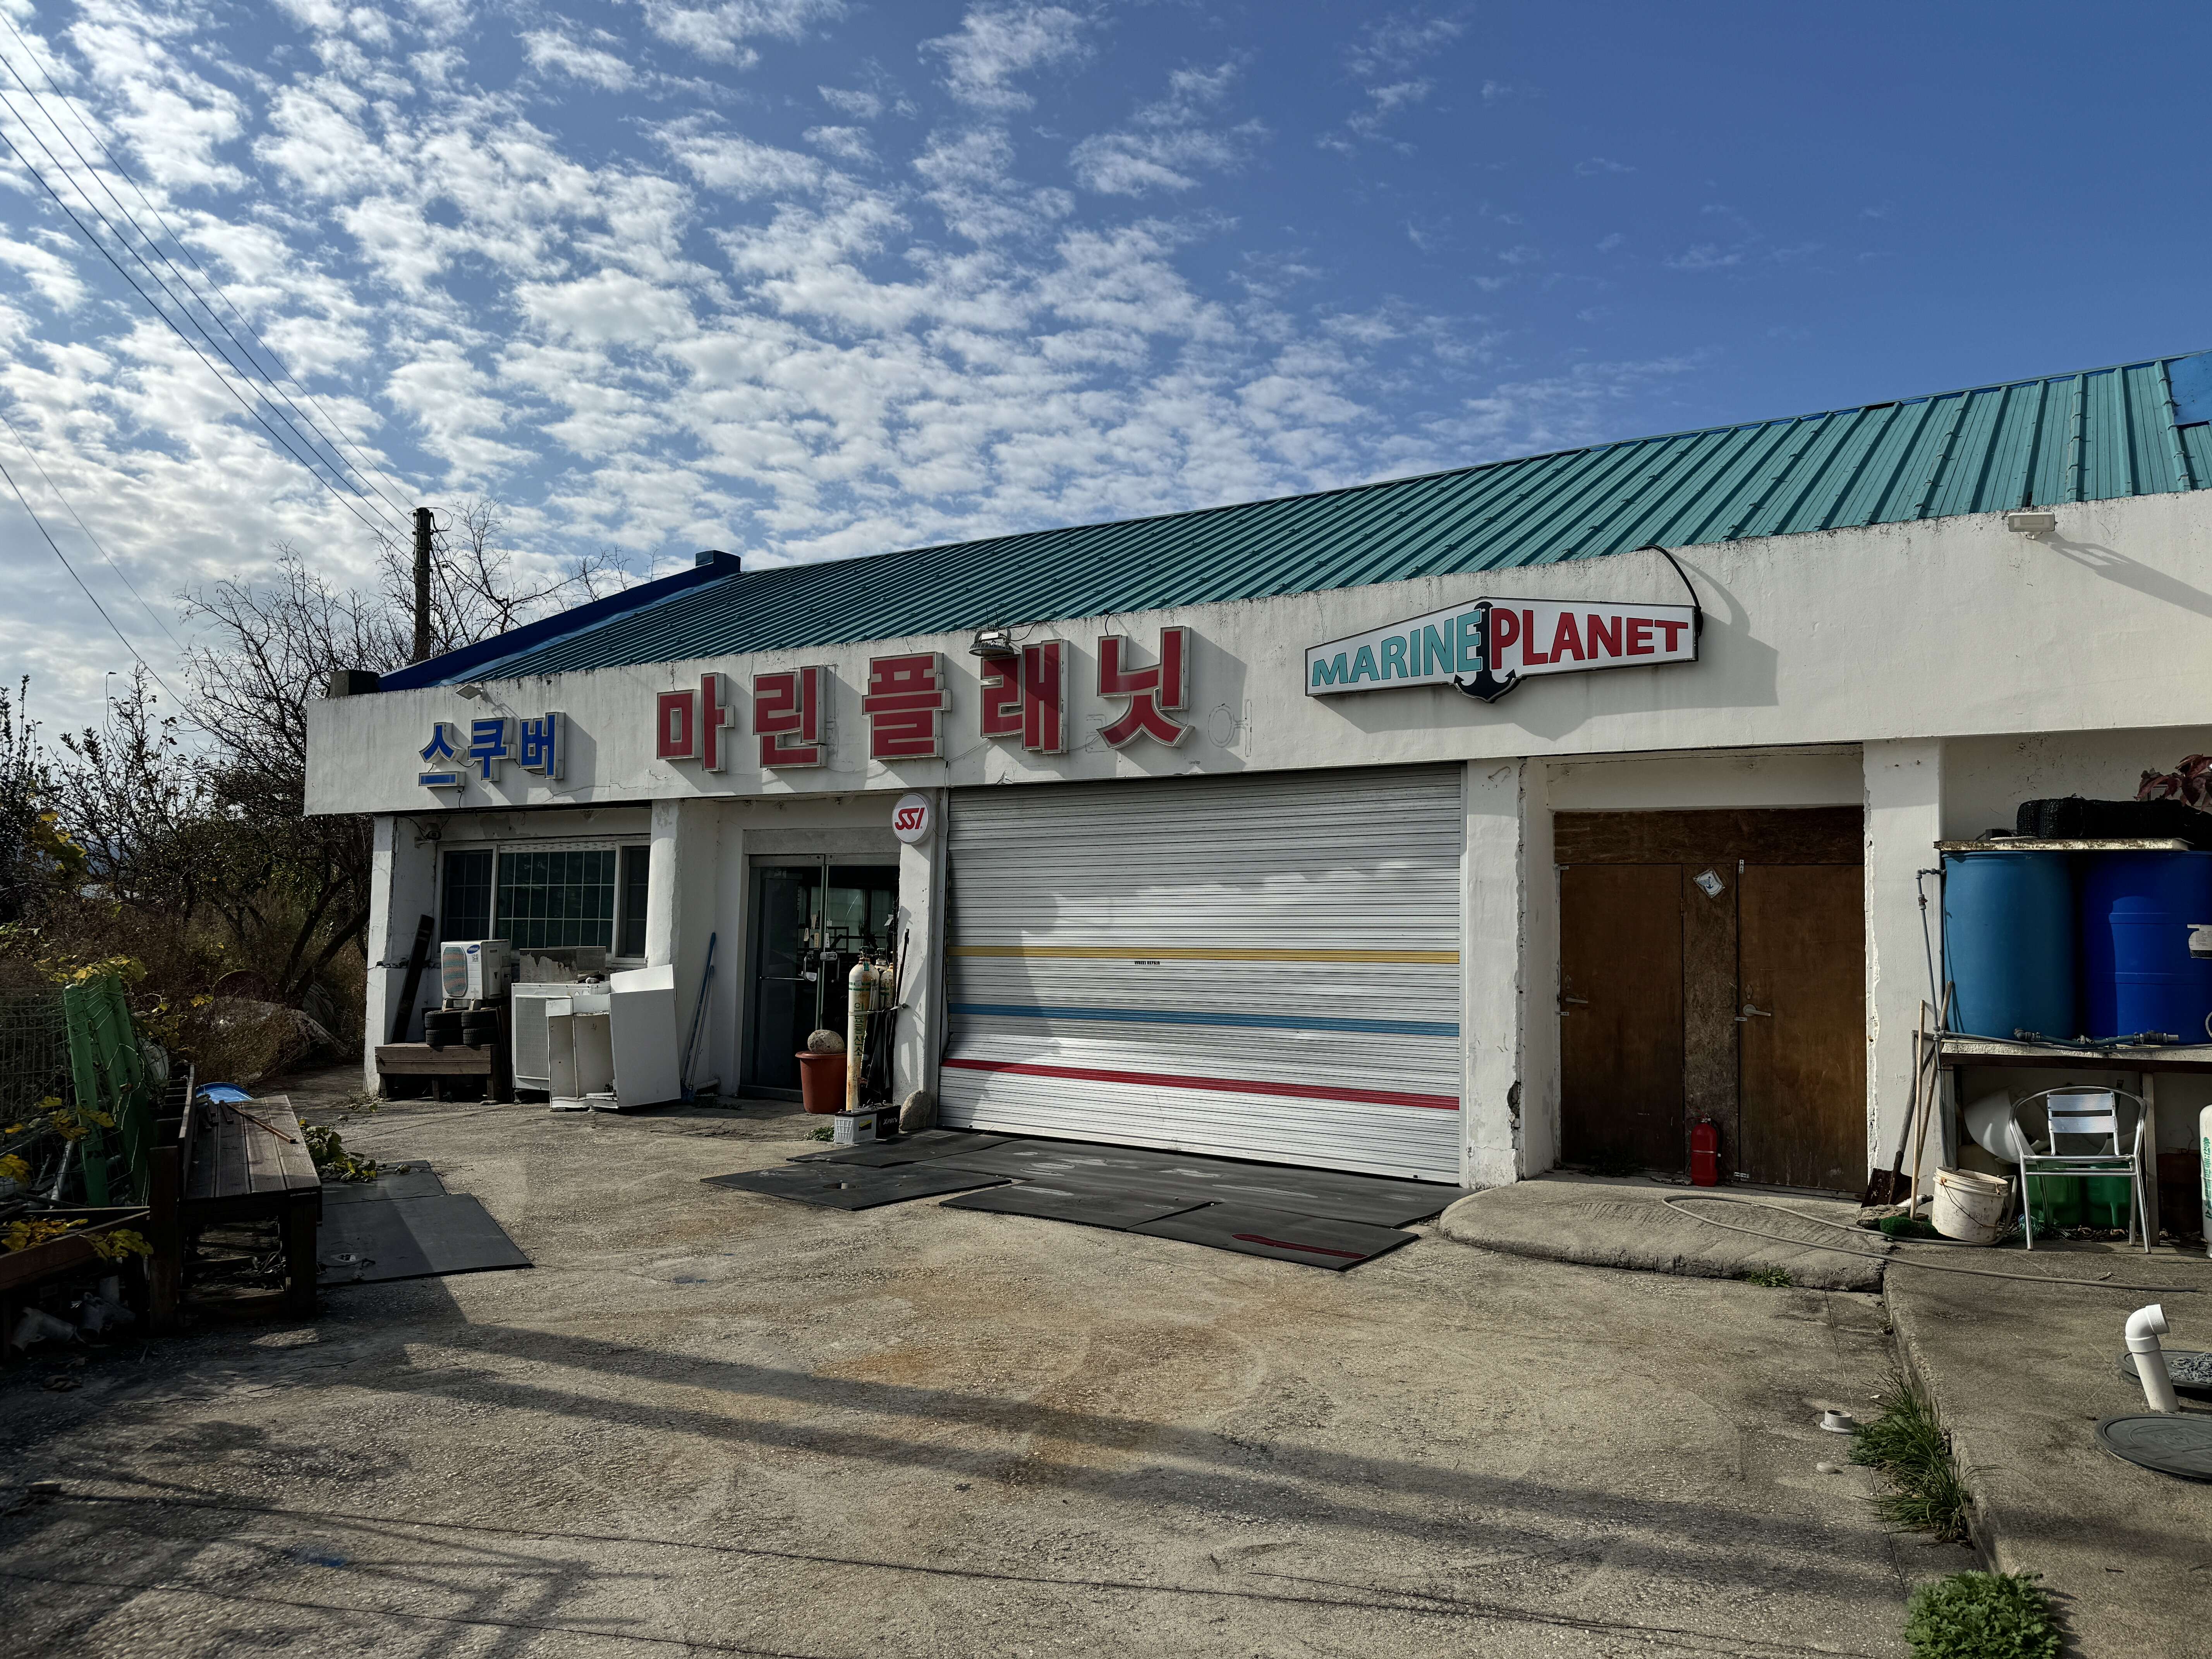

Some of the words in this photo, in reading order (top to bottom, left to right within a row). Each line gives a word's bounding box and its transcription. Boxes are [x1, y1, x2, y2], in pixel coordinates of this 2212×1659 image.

[1311, 609, 1482, 687] MARINE
[1490, 608, 1688, 670] PLANET
[418, 711, 561, 787] 스쿠버
[657, 626, 1190, 772] 마린플래닛
[895, 807, 925, 830] SSI
